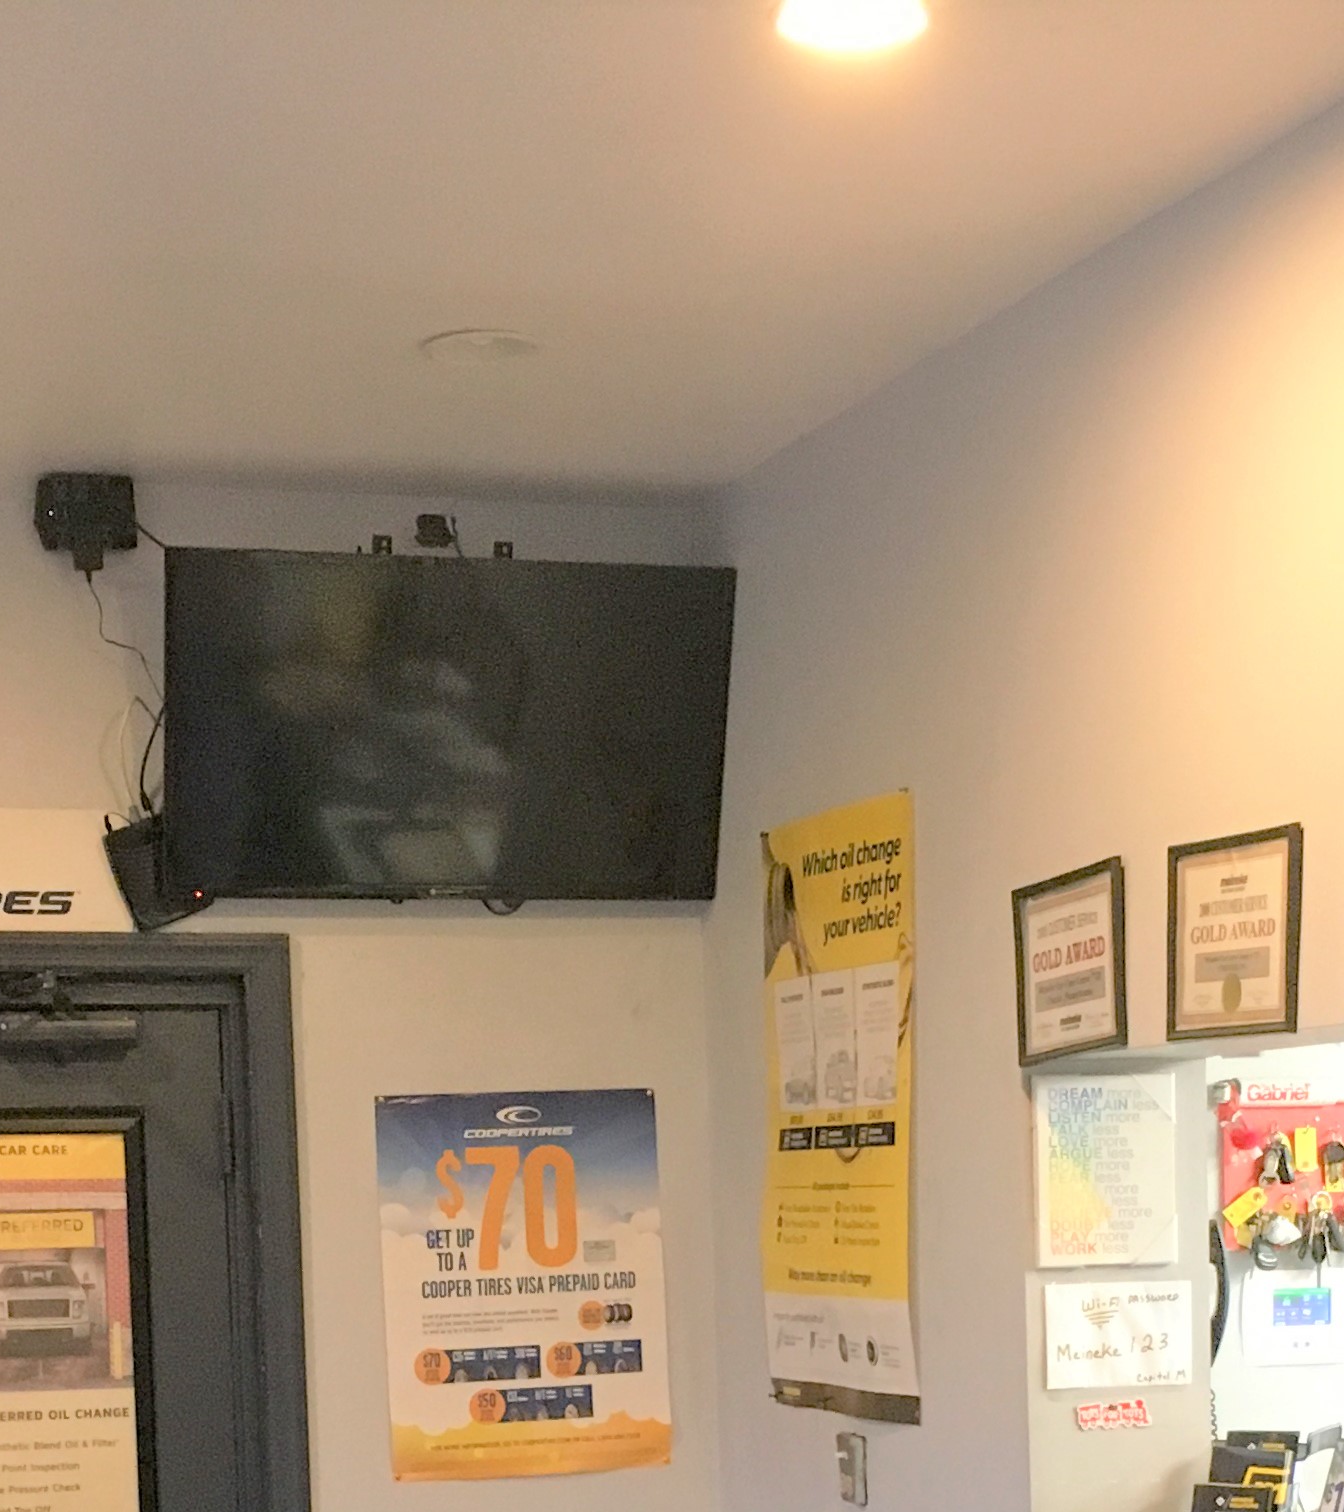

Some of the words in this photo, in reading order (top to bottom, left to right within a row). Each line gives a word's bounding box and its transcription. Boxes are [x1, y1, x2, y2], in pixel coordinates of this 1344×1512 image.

[802, 847, 838, 878] Which
[840, 843, 854, 870] oil
[857, 837, 901, 865] change
[842, 877, 851, 903] is
[853, 872, 882, 905] right
[884, 868, 902, 901] for
[823, 917, 850, 947] your
[852, 901, 901, 934] vehicle?
[1191, 923, 1227, 945] GOLD
[1229, 918, 1276, 940] AWARD
[1033, 947, 1062, 973] GOLD
[1065, 935, 1105, 965] AWARD
[1048, 1087, 1103, 1100] DREAM
[1107, 1089, 1141, 1099] more
[1247, 1082, 1311, 1101] Gabriel
[1048, 1099, 1128, 1112] COMPLAIN
[1133, 1099, 1160, 1110] less
[1048, 1112, 1101, 1124] LISTEN
[1106, 1113, 1140, 1123] more
[463, 1126, 574, 1139] COOPERTIRES
[1049, 1124, 1088, 1136] TALK
[1092, 1124, 1119, 1135] less
[1049, 1135, 1089, 1148] LOVE
[1094, 1136, 1128, 1147] more
[0, 1145, 26, 1156] CAR
[32, 1145, 68, 1155] CARE
[1049, 1147, 1103, 1160] ARGUE
[1108, 1148, 1134, 1159] less
[1096, 1160, 1130, 1171] more
[1094, 1172, 1121, 1183] less
[1104, 1184, 1139, 1194] more
[436, 1144, 578, 1270] $70
[1112, 1195, 1138, 1206] less
[1118, 1207, 1153, 1218] more
[1108, 1219, 1134, 1230] less
[426, 1229, 451, 1249] GET
[456, 1228, 475, 1248] UP
[1051, 1232, 1091, 1243] PLAY
[1094, 1231, 1128, 1242] more
[1051, 1242, 1097, 1255] WORK
[1102, 1242, 1129, 1253] less
[436, 1251, 453, 1272] TO
[458, 1251, 467, 1270] A
[421, 1279, 472, 1299] COOPER
[476, 1278, 512, 1296] TIRES
[516, 1276, 545, 1294] VISA
[549, 1272, 600, 1293] PREPAID
[604, 1271, 636, 1290] CARD
[423, 1352, 441, 1369] $70
[48, 1409, 70, 1420] OIL
[75, 1407, 130, 1419] CHANGE
